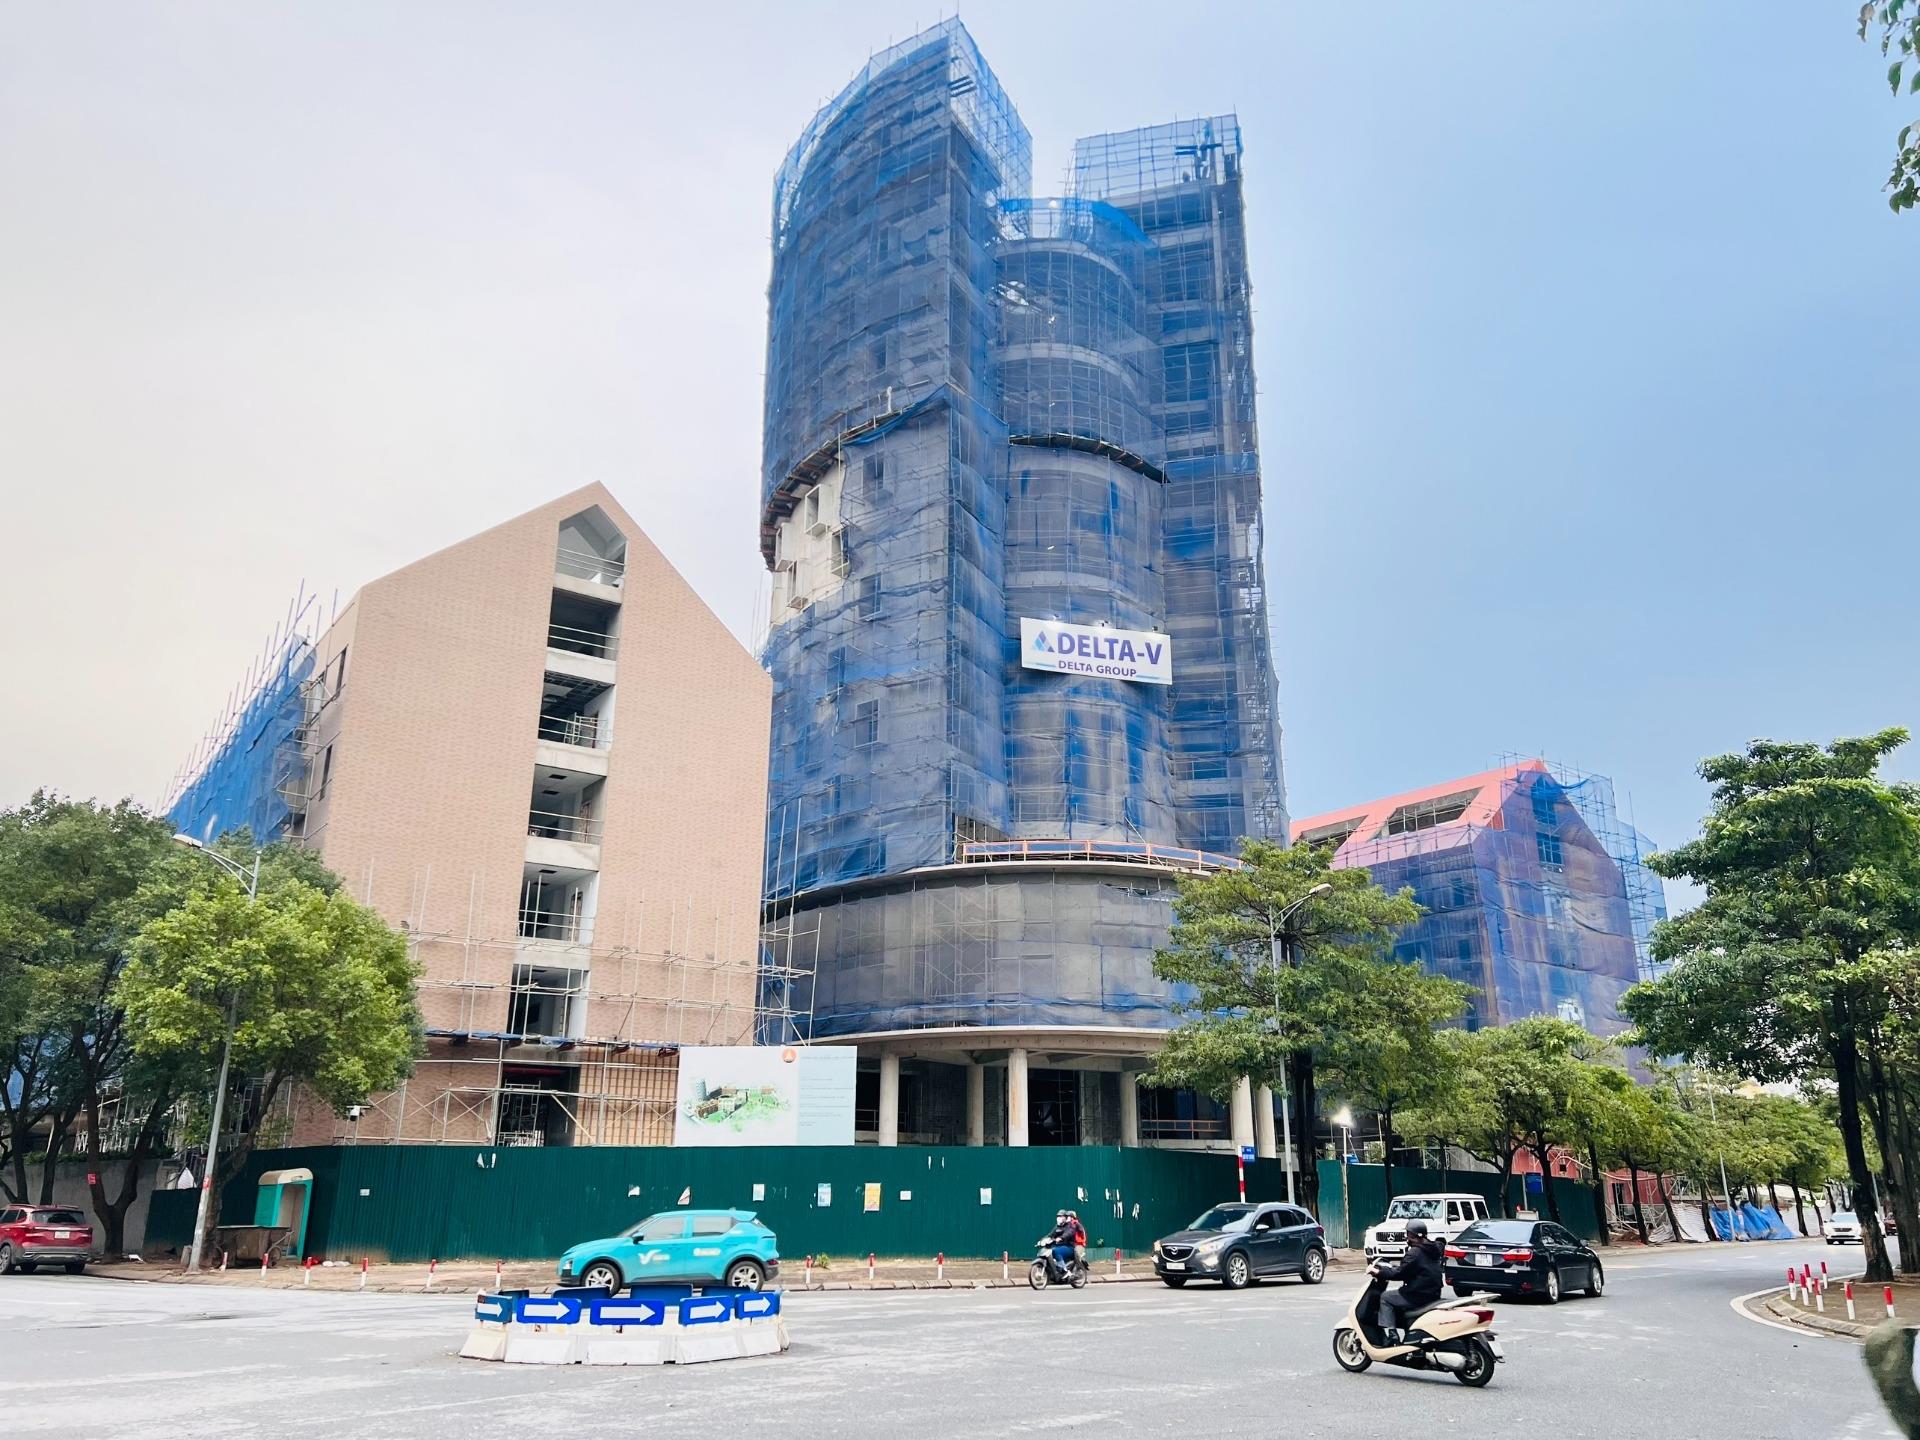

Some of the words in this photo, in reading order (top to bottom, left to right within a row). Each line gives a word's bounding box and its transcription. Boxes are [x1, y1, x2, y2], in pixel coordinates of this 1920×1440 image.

[1057, 632, 1162, 665] DELTA-V
[1058, 660, 1093, 673] DELTA
[1096, 665, 1137, 677] GROUP
